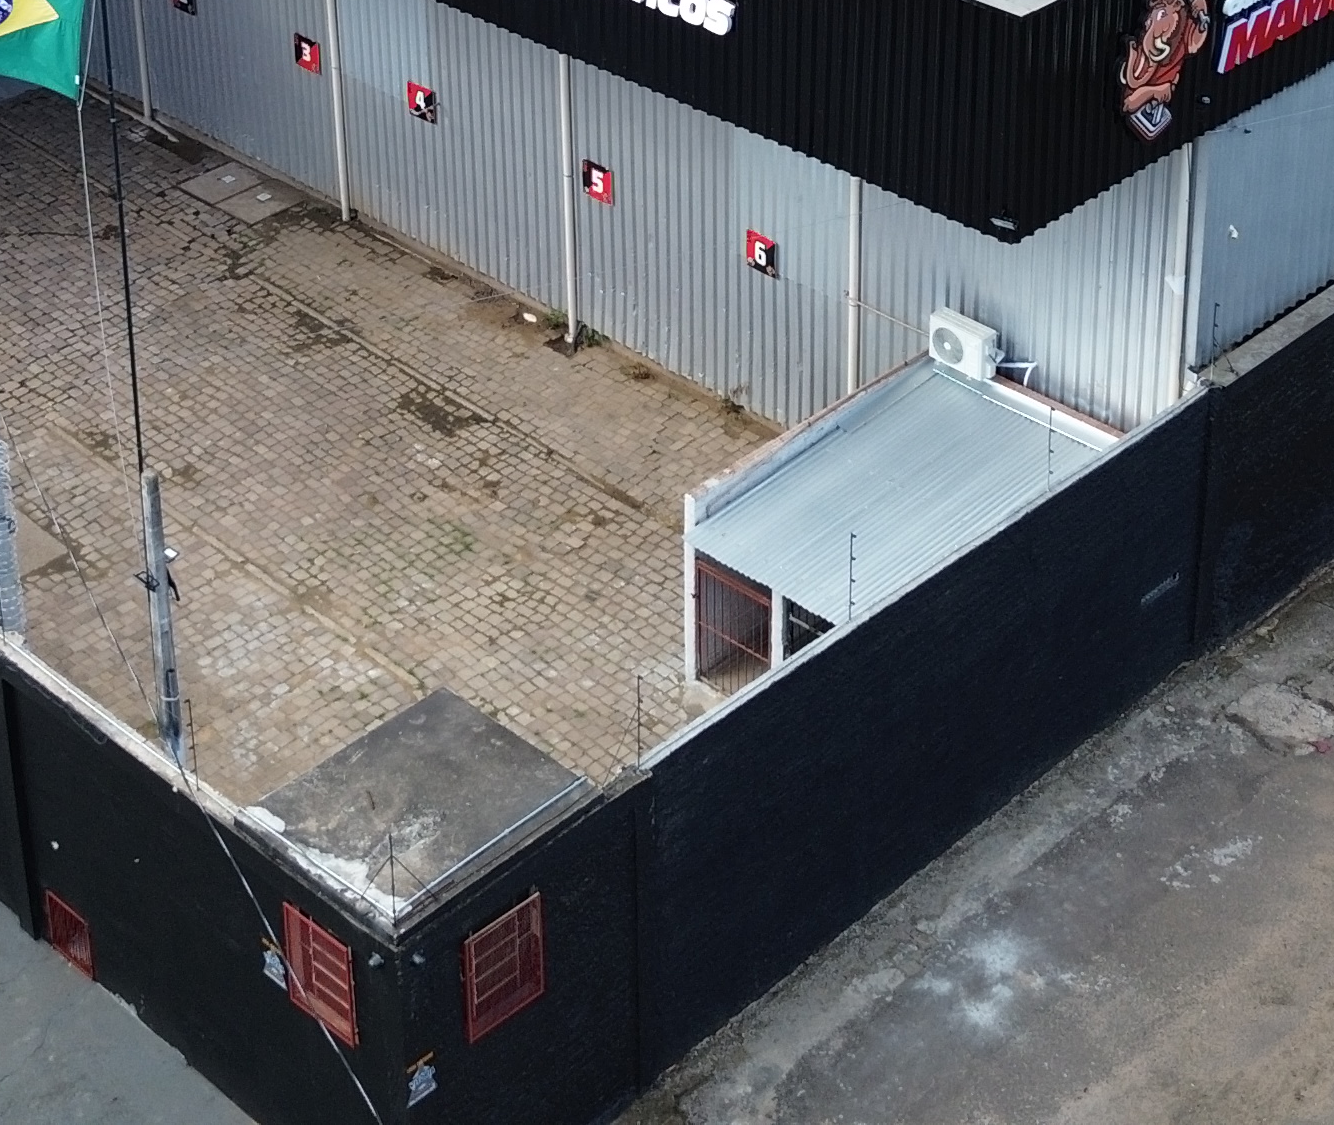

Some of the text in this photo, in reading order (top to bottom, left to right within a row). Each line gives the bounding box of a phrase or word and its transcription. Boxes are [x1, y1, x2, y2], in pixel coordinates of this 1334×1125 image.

[300, 41, 311, 62] 3
[415, 90, 426, 110] 4
[591, 168, 604, 194] 5
[754, 240, 767, 267] 6
